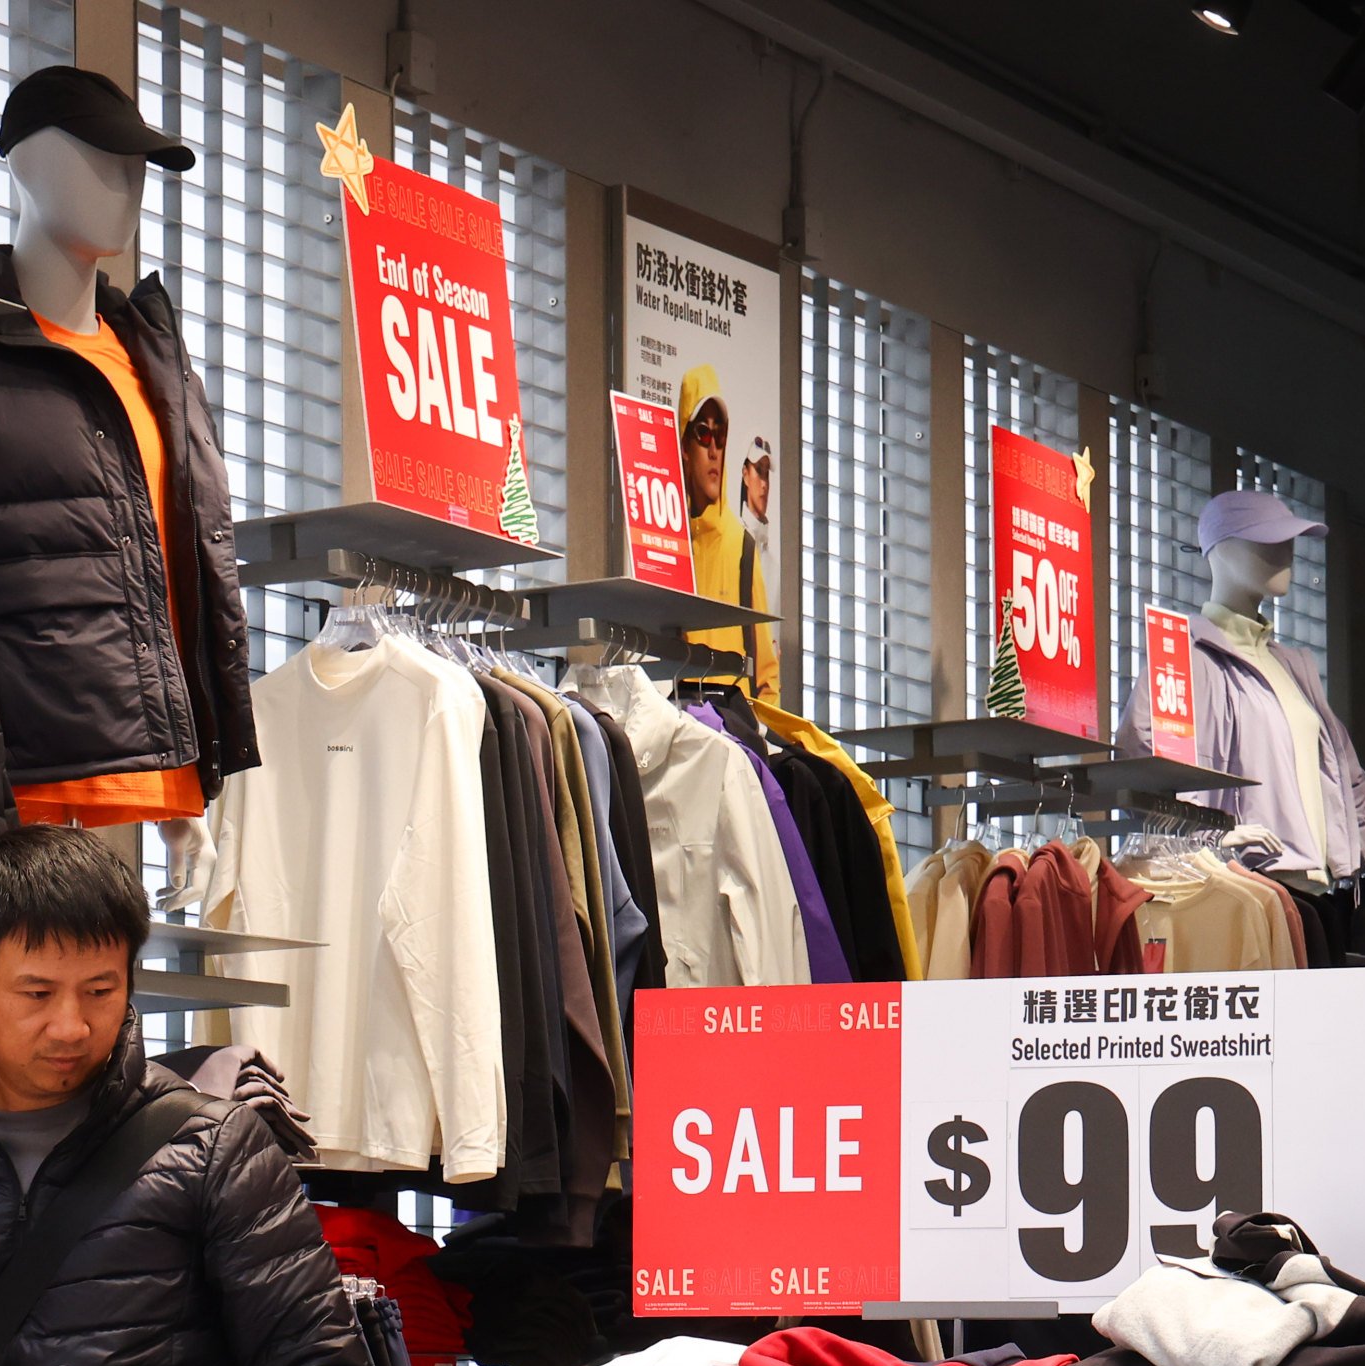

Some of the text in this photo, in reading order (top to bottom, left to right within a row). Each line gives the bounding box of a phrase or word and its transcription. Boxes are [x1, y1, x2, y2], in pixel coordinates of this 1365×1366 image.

[387, 181, 505, 259] SALE SALE SALE
[375, 244, 490, 321] End of Season
[636, 284, 731, 338] Water Repellent Jacket
[380, 295, 503, 448] SALE
[638, 408, 653, 424] SALE
[374, 448, 495, 517] SALE SALE SALE
[1013, 549, 1079, 660] 50 OFF
[1060, 619, 1080, 669] %
[1156, 673, 1177, 714] 30
[703, 1005, 763, 1034] SALE
[839, 1002, 900, 1031] SALE
[1021, 984, 1261, 1025] 精選印花衛衣
[1011, 1031, 1272, 1062] Selected Printed Sweatshirt
[671, 1104, 863, 1195] SALE
[636, 1268, 694, 1297] SALE
[703, 1266, 763, 1295] SALE
[770, 1266, 830, 1295] SALE
